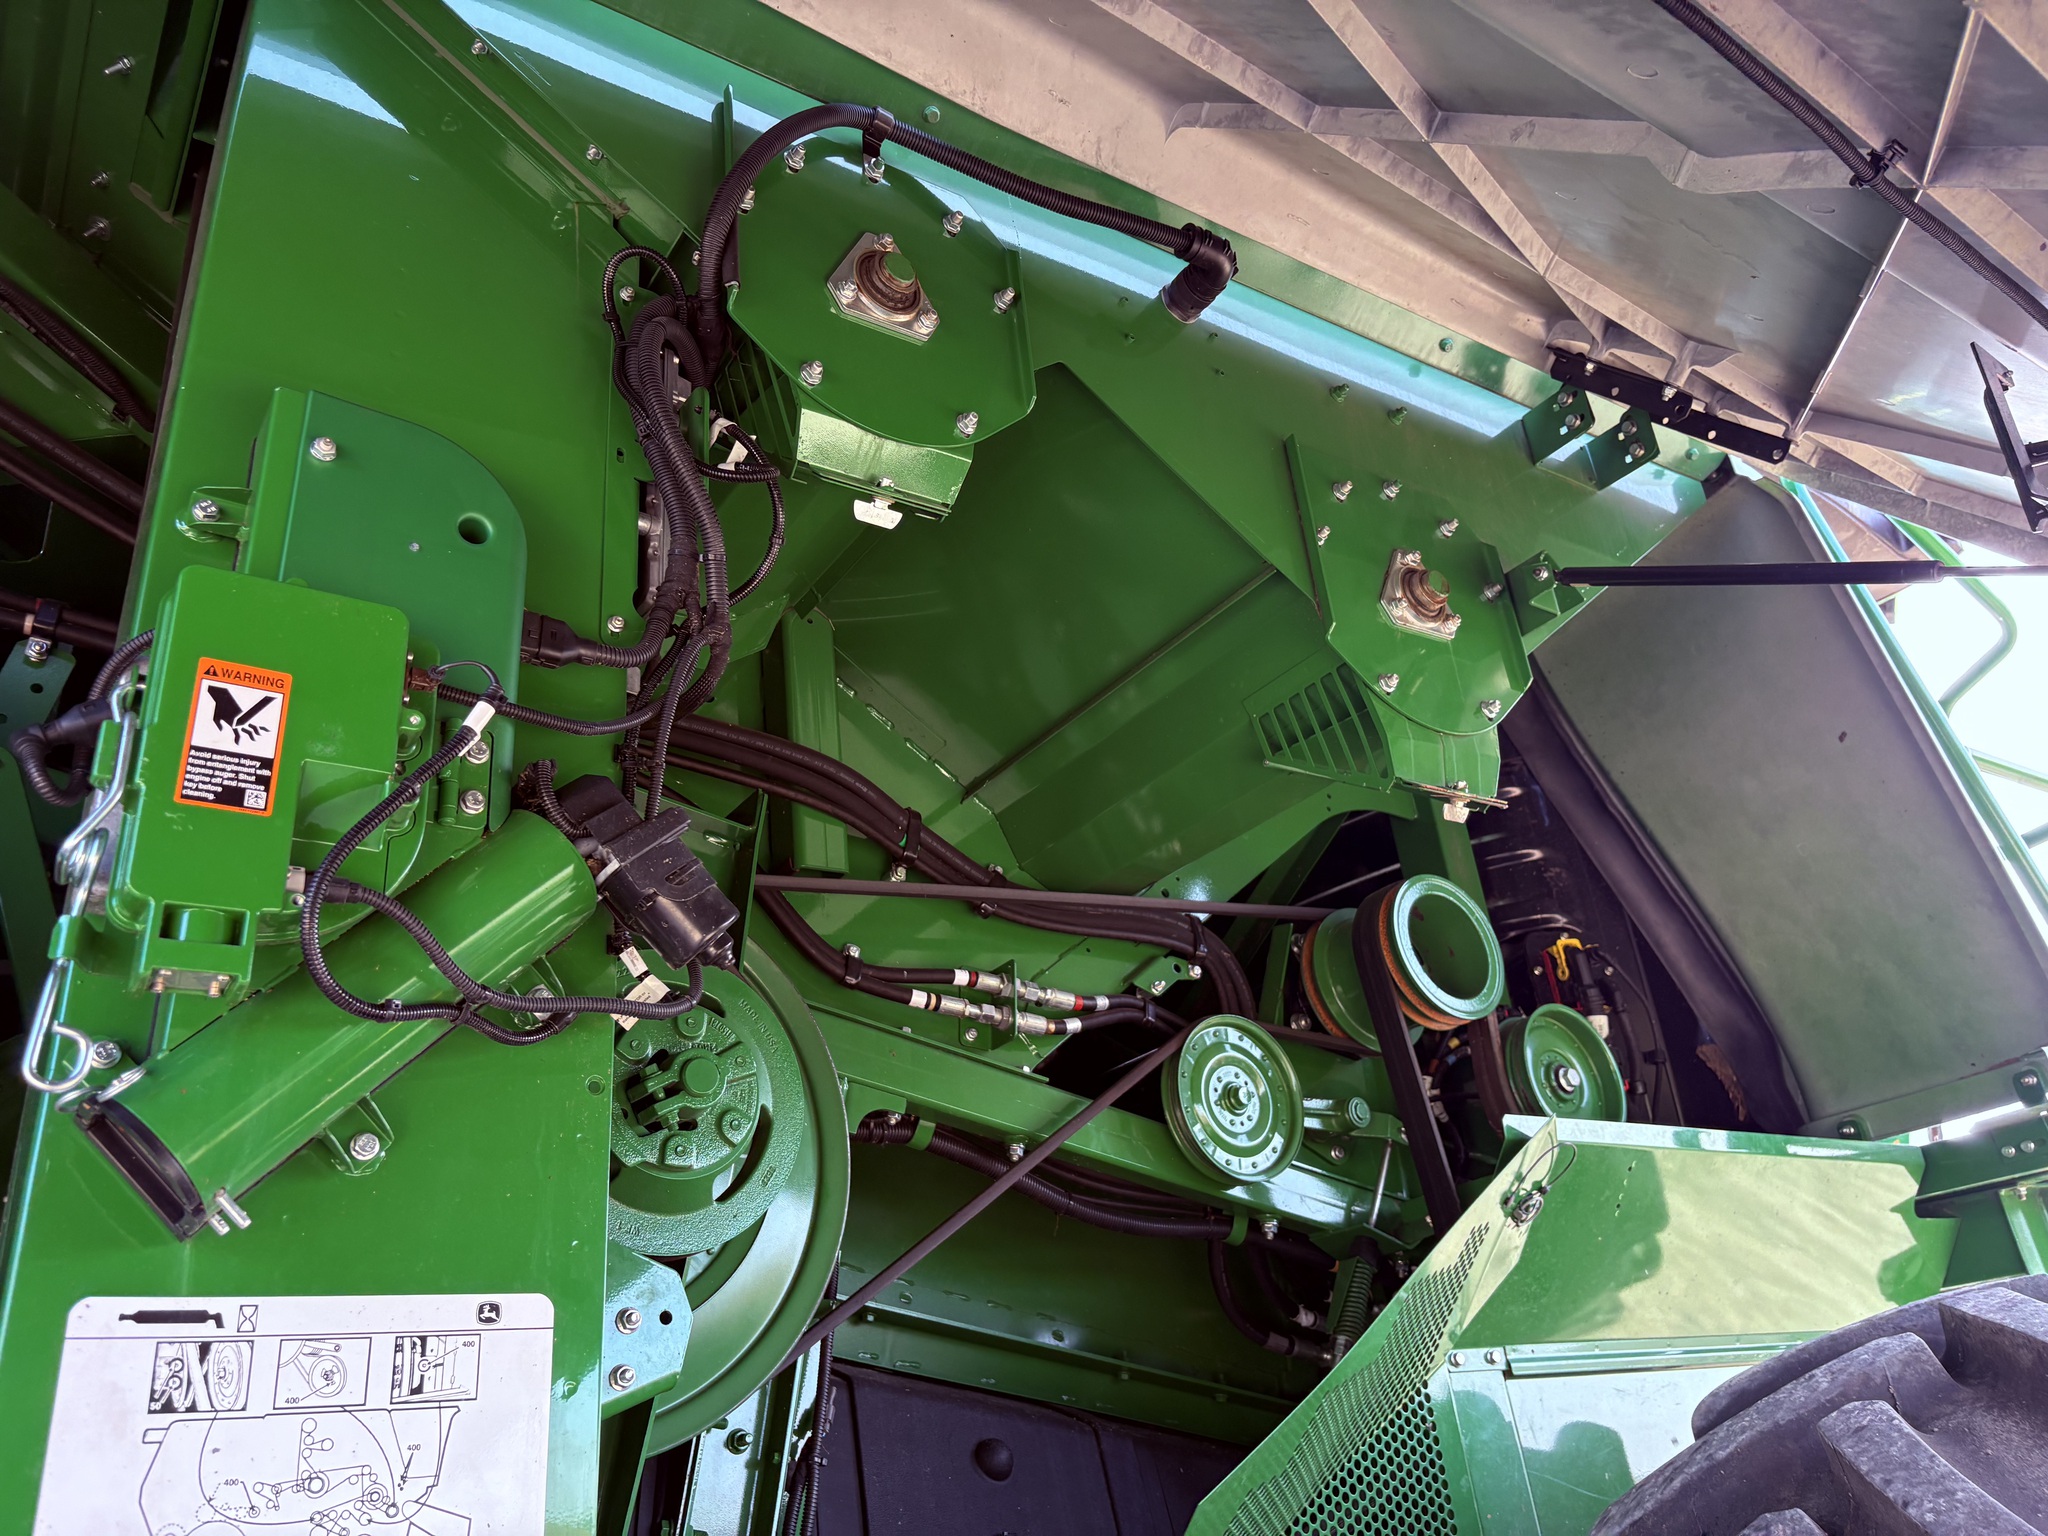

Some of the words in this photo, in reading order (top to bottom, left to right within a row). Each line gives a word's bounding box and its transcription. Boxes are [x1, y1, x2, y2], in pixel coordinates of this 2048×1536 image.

[221, 668, 285, 689] WARNING
[190, 749, 211, 759] Avoid
[212, 753, 240, 764] serious
[240, 758, 261, 768] injury
[188, 757, 206, 766] from
[206, 759, 256, 774] entanglement
[256, 768, 272, 777] with
[186, 765, 214, 775] bypass
[213, 769, 238, 779] auger.
[238, 773, 256, 782] Shut
[183, 780, 198, 789] key
[198, 782, 223, 792] before
[184, 773, 211, 783] engine
[211, 776, 223, 784] off
[237, 781, 265, 791] remove
[182, 788, 216, 800] cleaning.
[461, 1339, 475, 1348] 400
[149, 1401, 162, 1410] 50
[284, 1396, 300, 1405] 400
[406, 1443, 421, 1451] 400
[223, 1478, 239, 1486] 400
